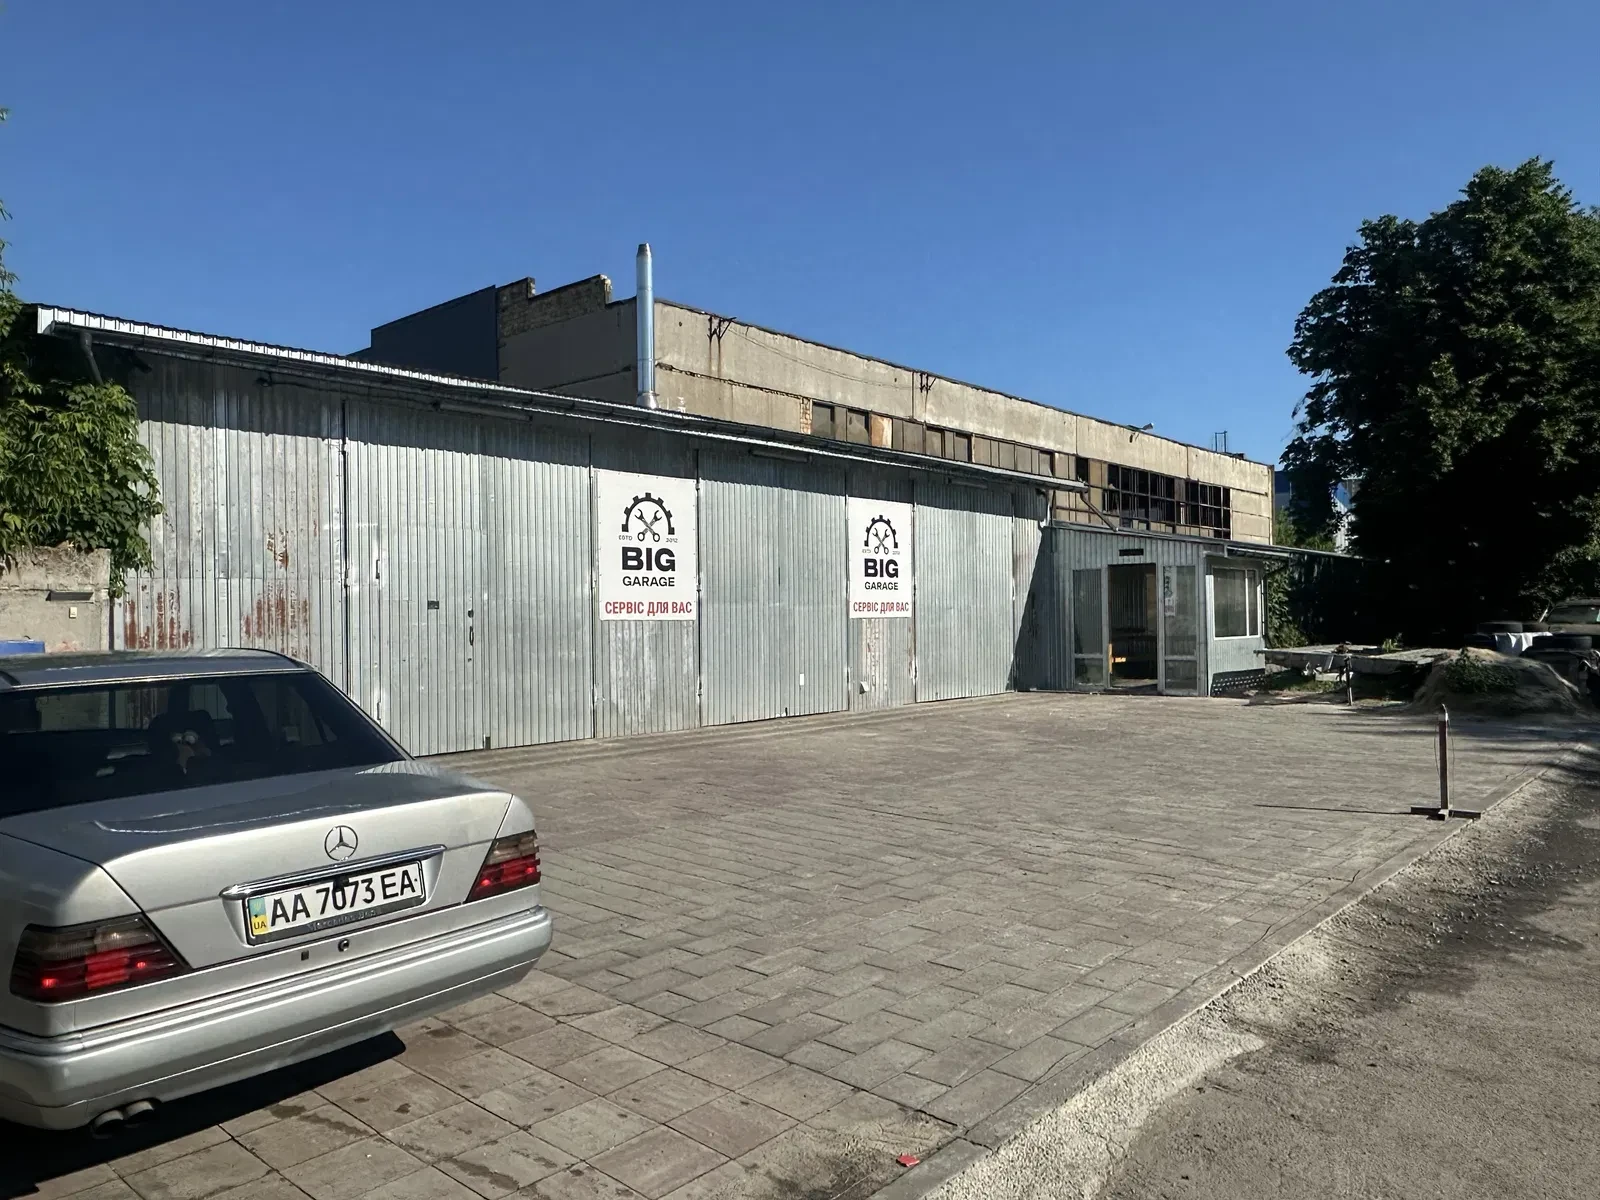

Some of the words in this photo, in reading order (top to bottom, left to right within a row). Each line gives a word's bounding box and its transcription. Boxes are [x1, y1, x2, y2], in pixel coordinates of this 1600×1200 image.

[621, 546, 676, 572] BIG
[864, 558, 898, 578] BIG
[622, 576, 675, 587] GARAGE
[864, 581, 898, 591] GARAGE
[605, 601, 644, 614] СЕРВІС
[647, 601, 669, 616] ДЛЯ
[671, 601, 692, 614] ВАС
[853, 602, 879, 612] СЕРВІС
[880, 602, 895, 614] ДЛЯ
[896, 602, 909, 612] ВАС
[270, 893, 311, 927] AA
[316, 877, 376, 915] 7073
[380, 869, 416, 900] EA
[253, 920, 267, 930] UA
